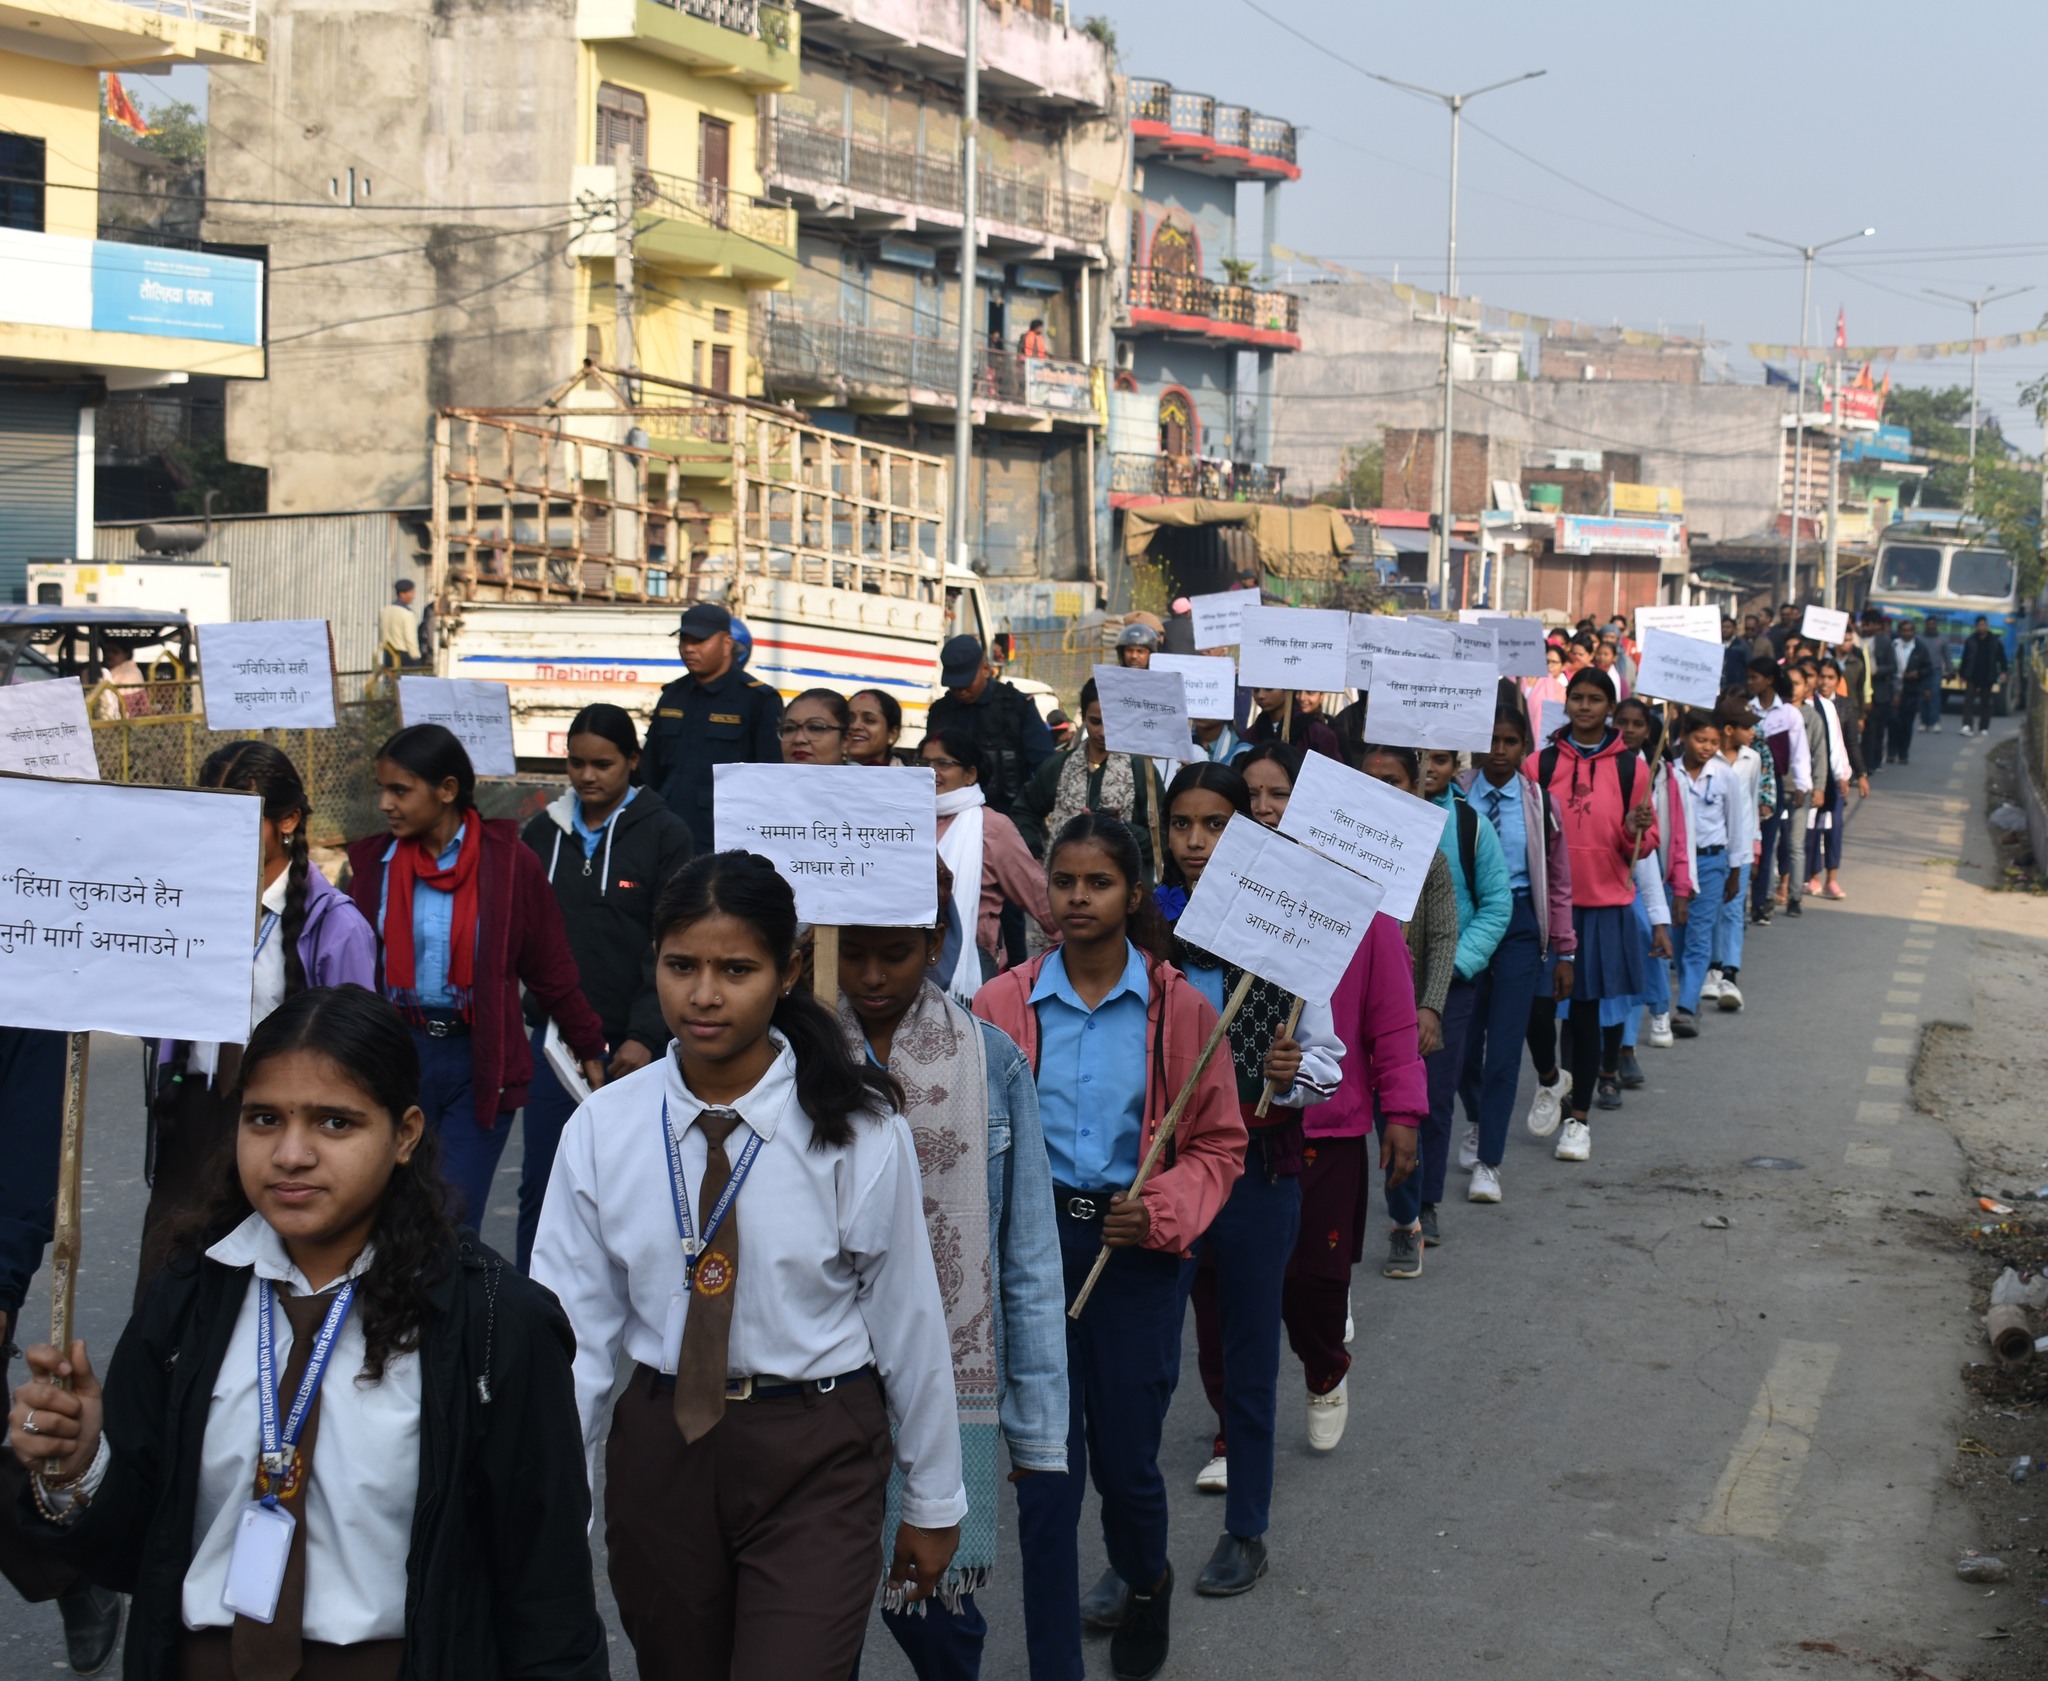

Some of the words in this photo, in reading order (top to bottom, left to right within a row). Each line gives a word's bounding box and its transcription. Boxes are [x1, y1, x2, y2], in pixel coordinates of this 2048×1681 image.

[187, 288, 214, 307] शाखा
[232, 658, 286, 675] “प्रविधिको
[288, 658, 309, 675] सही
[536, 663, 638, 682] Mahindra
[234, 687, 277, 711] सदुपयोग
[759, 825, 807, 841] सम्मान
[811, 821, 838, 848] दिनु
[842, 821, 852, 841] नै
[857, 822, 916, 849] सुरक्षाको
[1309, 826, 1338, 847] कानुनी
[1338, 839, 1357, 854] मार्ग
[1357, 848, 1394, 872] अपनाउने
[1356, 821, 1389, 844] लुकाउने
[1390, 834, 1404, 852] हैन
[789, 860, 835, 876] आधार
[2, 867, 62, 898] “हिंसा
[68, 876, 148, 911] लुकाउने
[153, 878, 184, 908] हैन
[1238, 875, 1275, 902] सम्मान
[1275, 891, 1298, 918] दिनु
[1299, 900, 1308, 917] नै
[1308, 909, 1352, 939] सुरक्षाको
[0, 919, 37, 954] नुनी
[43, 922, 84, 949] मार्ग
[90, 928, 179, 956] अपनाउने
[1245, 913, 1282, 939] आधार
[671, 1156, 681, 1174] NATH
[674, 1174, 690, 1217] TAULESHWOR
[703, 1219, 717, 1241] SHREE
[711, 1180, 738, 1221] TAULESHWOR
[732, 1164, 746, 1184] NATH
[741, 1135, 760, 1167] SANSKRIT
[681, 1217, 692, 1238] SHREE
[261, 1279, 269, 1310] SECOND
[260, 1311, 271, 1347] SANSKRIT
[260, 1348, 271, 1370] NATH
[282, 1412, 301, 1442] SHREE
[292, 1362, 322, 1419] TAULESHWOR
[313, 1339, 331, 1367] NATH
[322, 1300, 345, 1341] SANSKRIT
[260, 1370, 275, 1424] TAULESHWOR
[264, 1423, 277, 1451] SHREE
